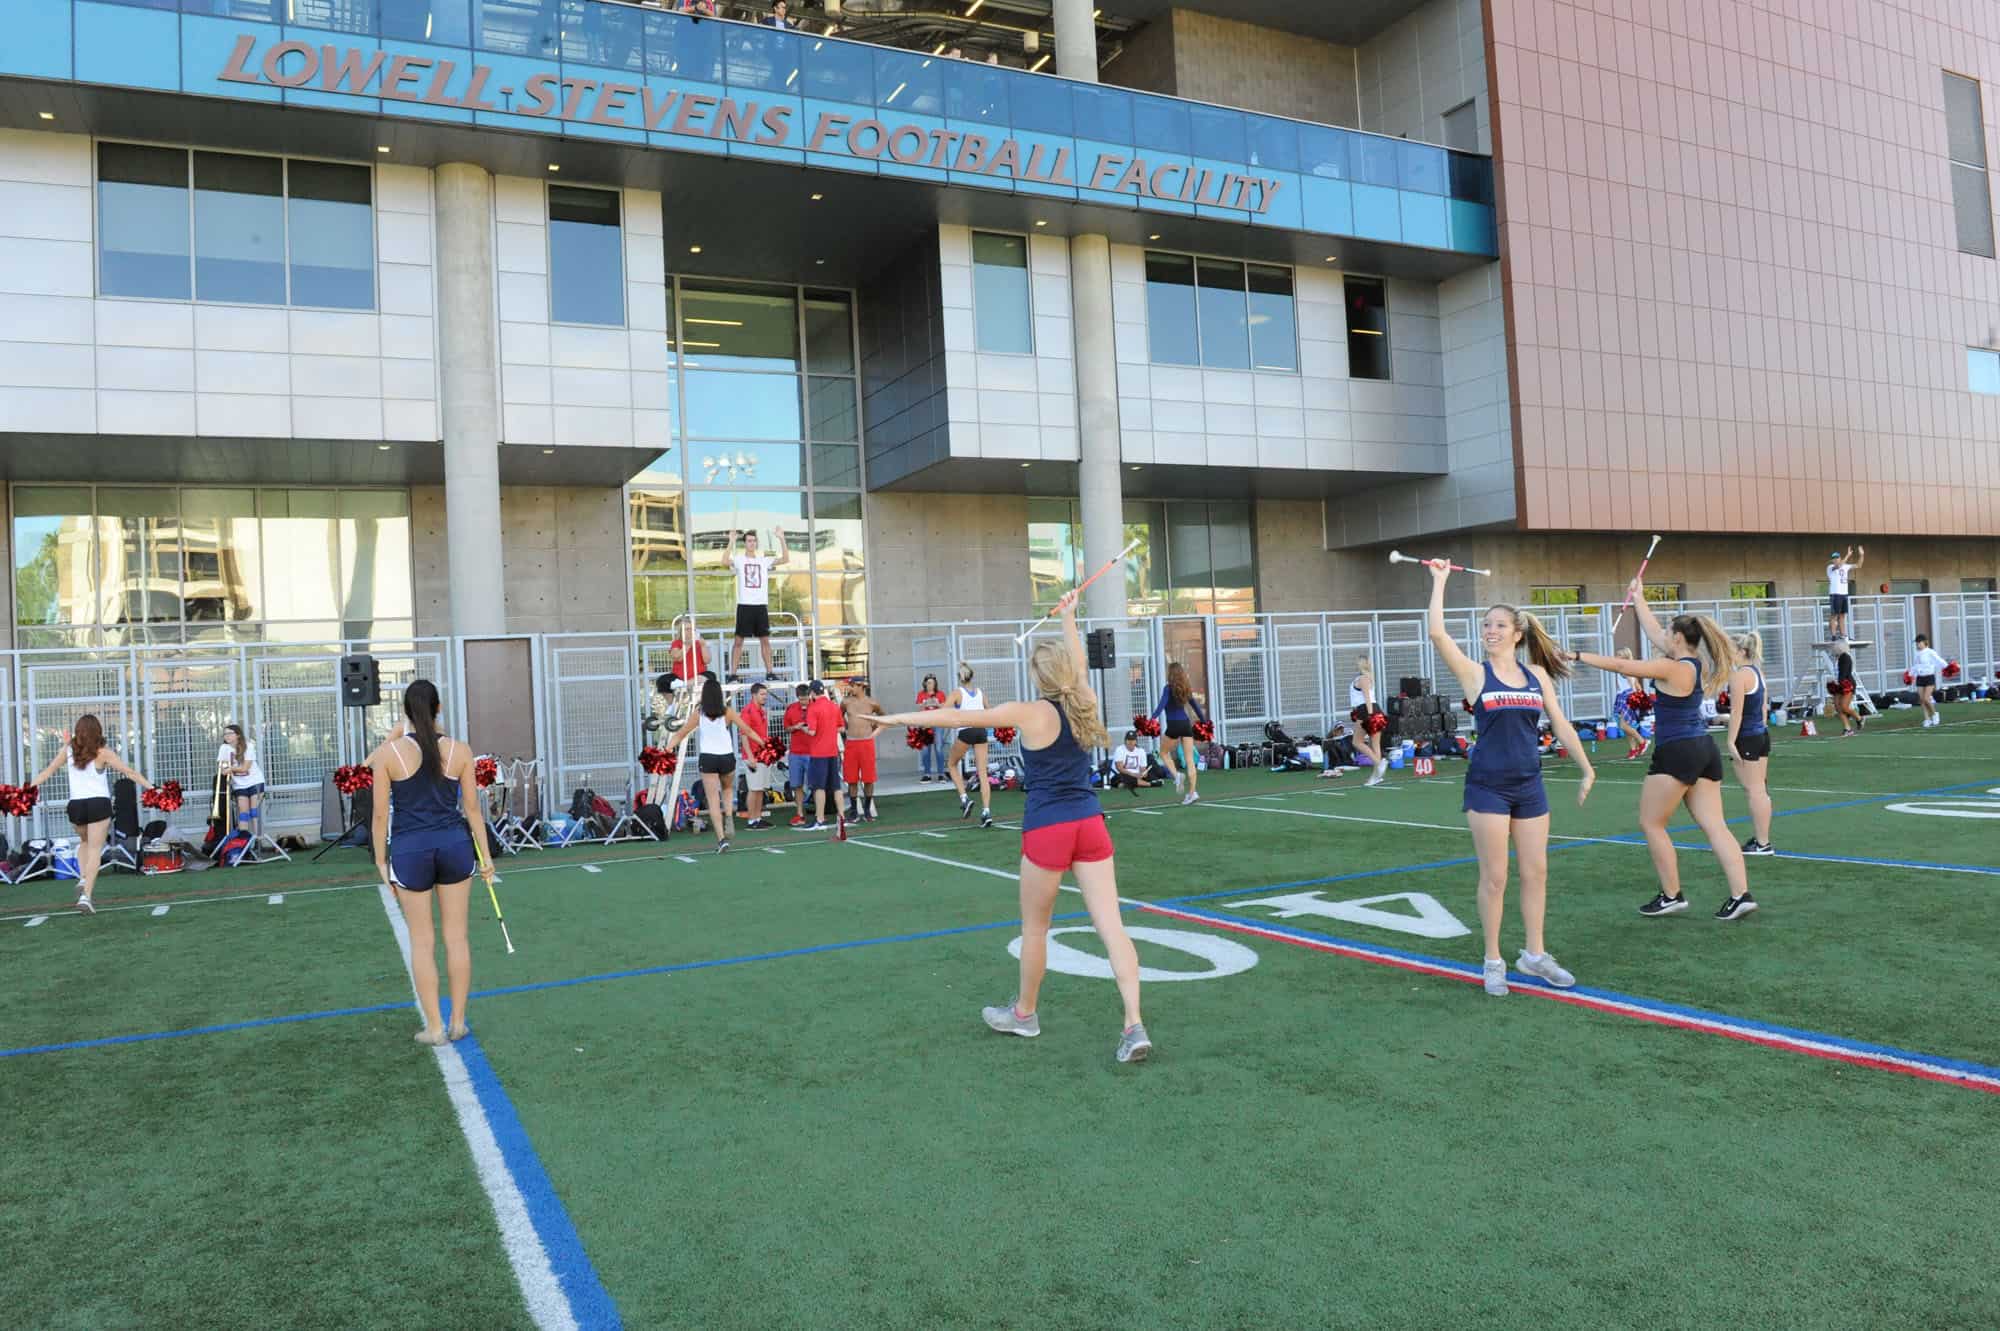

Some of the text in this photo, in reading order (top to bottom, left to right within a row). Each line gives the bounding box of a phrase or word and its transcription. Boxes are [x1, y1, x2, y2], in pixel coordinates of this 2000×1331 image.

[808, 111, 1073, 186] FOOTBALL
[1090, 154, 1281, 213] FACILITY
[1415, 758, 1433, 775] 40
